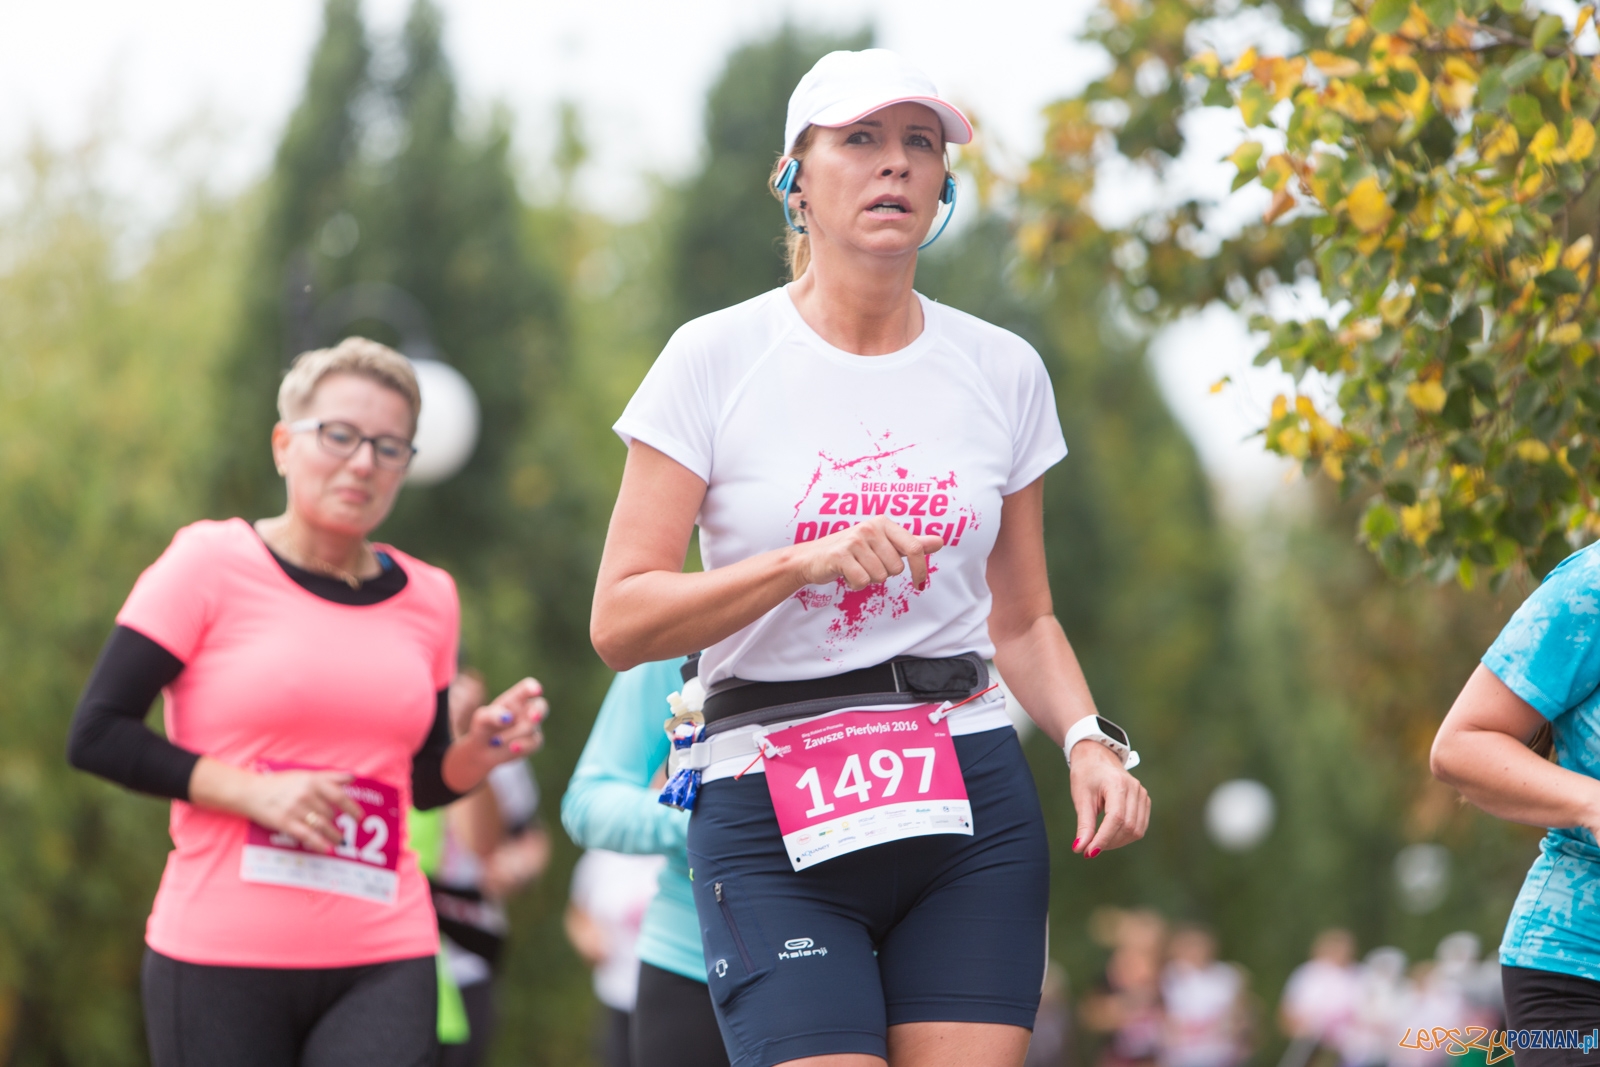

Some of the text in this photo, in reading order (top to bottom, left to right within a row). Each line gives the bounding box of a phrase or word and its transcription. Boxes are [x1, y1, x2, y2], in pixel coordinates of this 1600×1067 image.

[861, 482, 932, 493] BIEG KOBIET
[819, 492, 949, 517] zawsze
[803, 720, 919, 750] Zawsze Pier(w)si 2016
[795, 747, 936, 819] 1497
